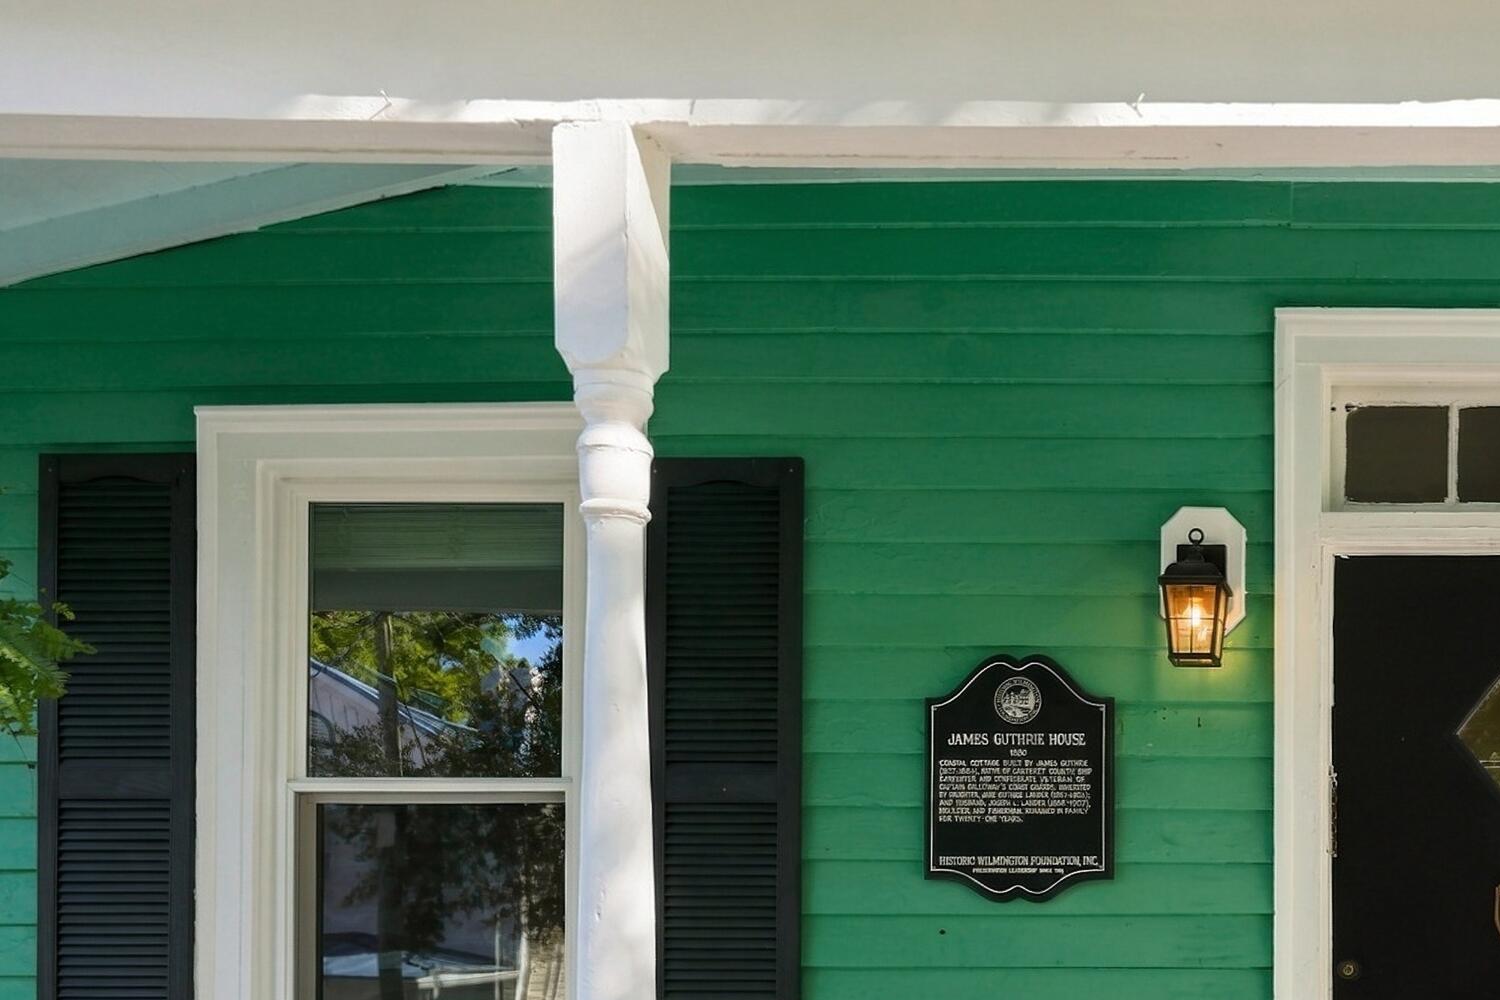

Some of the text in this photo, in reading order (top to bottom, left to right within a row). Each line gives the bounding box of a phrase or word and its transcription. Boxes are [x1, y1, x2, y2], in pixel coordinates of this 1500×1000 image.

[947, 732, 1086, 746] JAMES GUTHRIE HOUSE
[939, 759, 1089, 767] COASTAL COTTAGE BUILT BY JAMES GUTHRIE
[980, 767, 1001, 775] NATIVE
[1002, 767, 1011, 775] OF
[1012, 767, 1046, 775] CARTERET
[939, 775, 1086, 783] CARPENTER AND CONFEDERATE VETERAN OF
[939, 791, 947, 799] BY
[939, 799, 953, 807] AND
[988, 799, 1011, 807] JOSEPH
[972, 807, 986, 815] AND
[1056, 807, 1064, 815] IN
[1064, 807, 1089, 815] FAMILY
[938, 815, 953, 823] FOR
[954, 815, 998, 823] TWENTY-ONE
[939, 855, 1099, 868] HISTORIC WILMINGTON FOUNDATION, INC.
